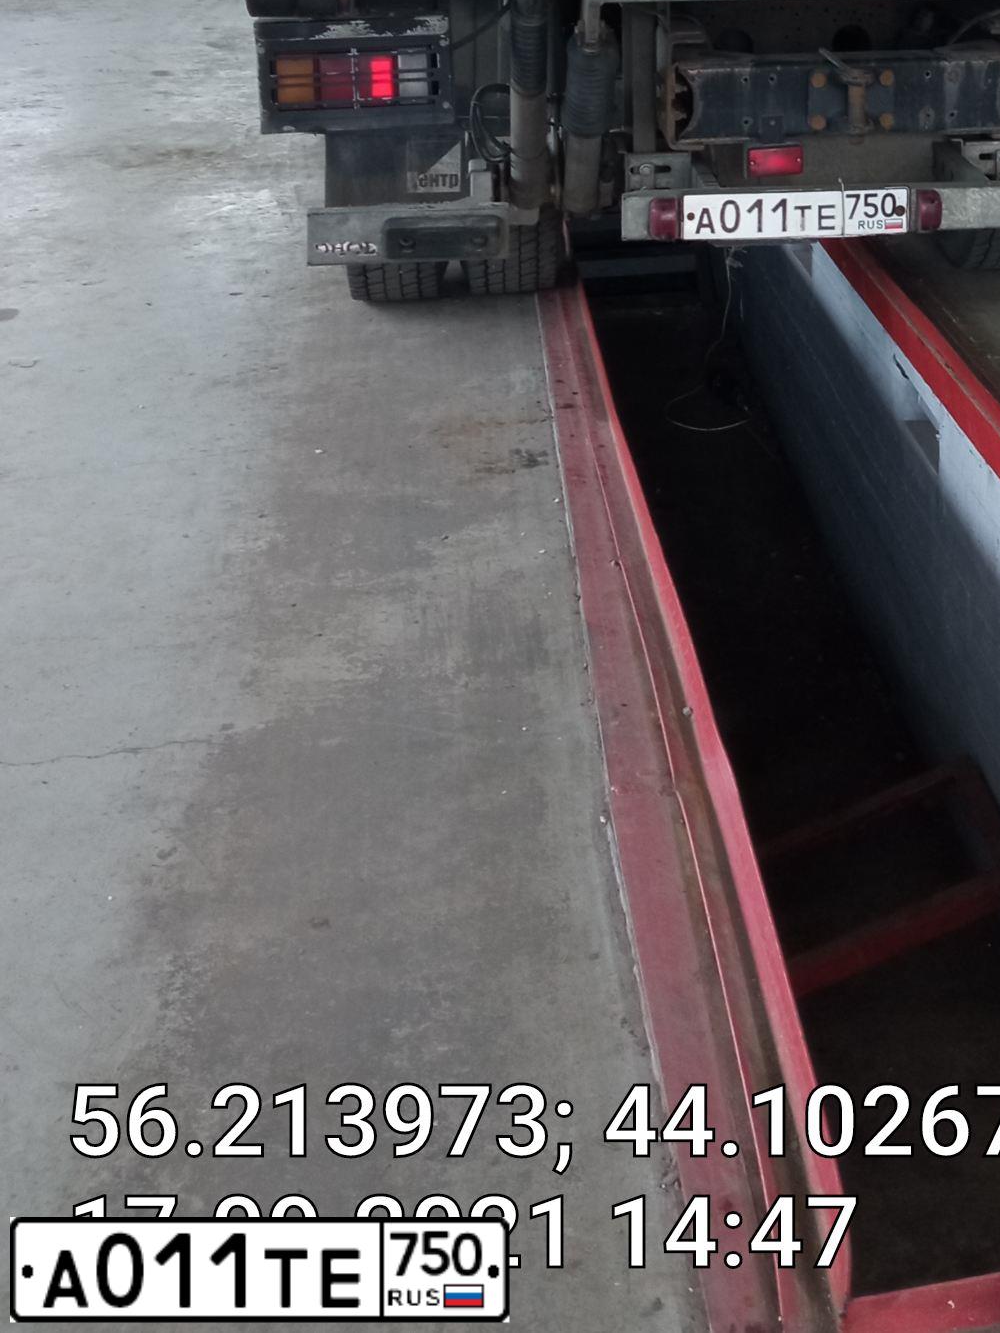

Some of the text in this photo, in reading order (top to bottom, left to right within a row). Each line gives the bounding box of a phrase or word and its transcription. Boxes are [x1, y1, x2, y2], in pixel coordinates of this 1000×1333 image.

[695, 192, 897, 235] А011ТЕ 750
[857, 219, 884, 230] RUS
